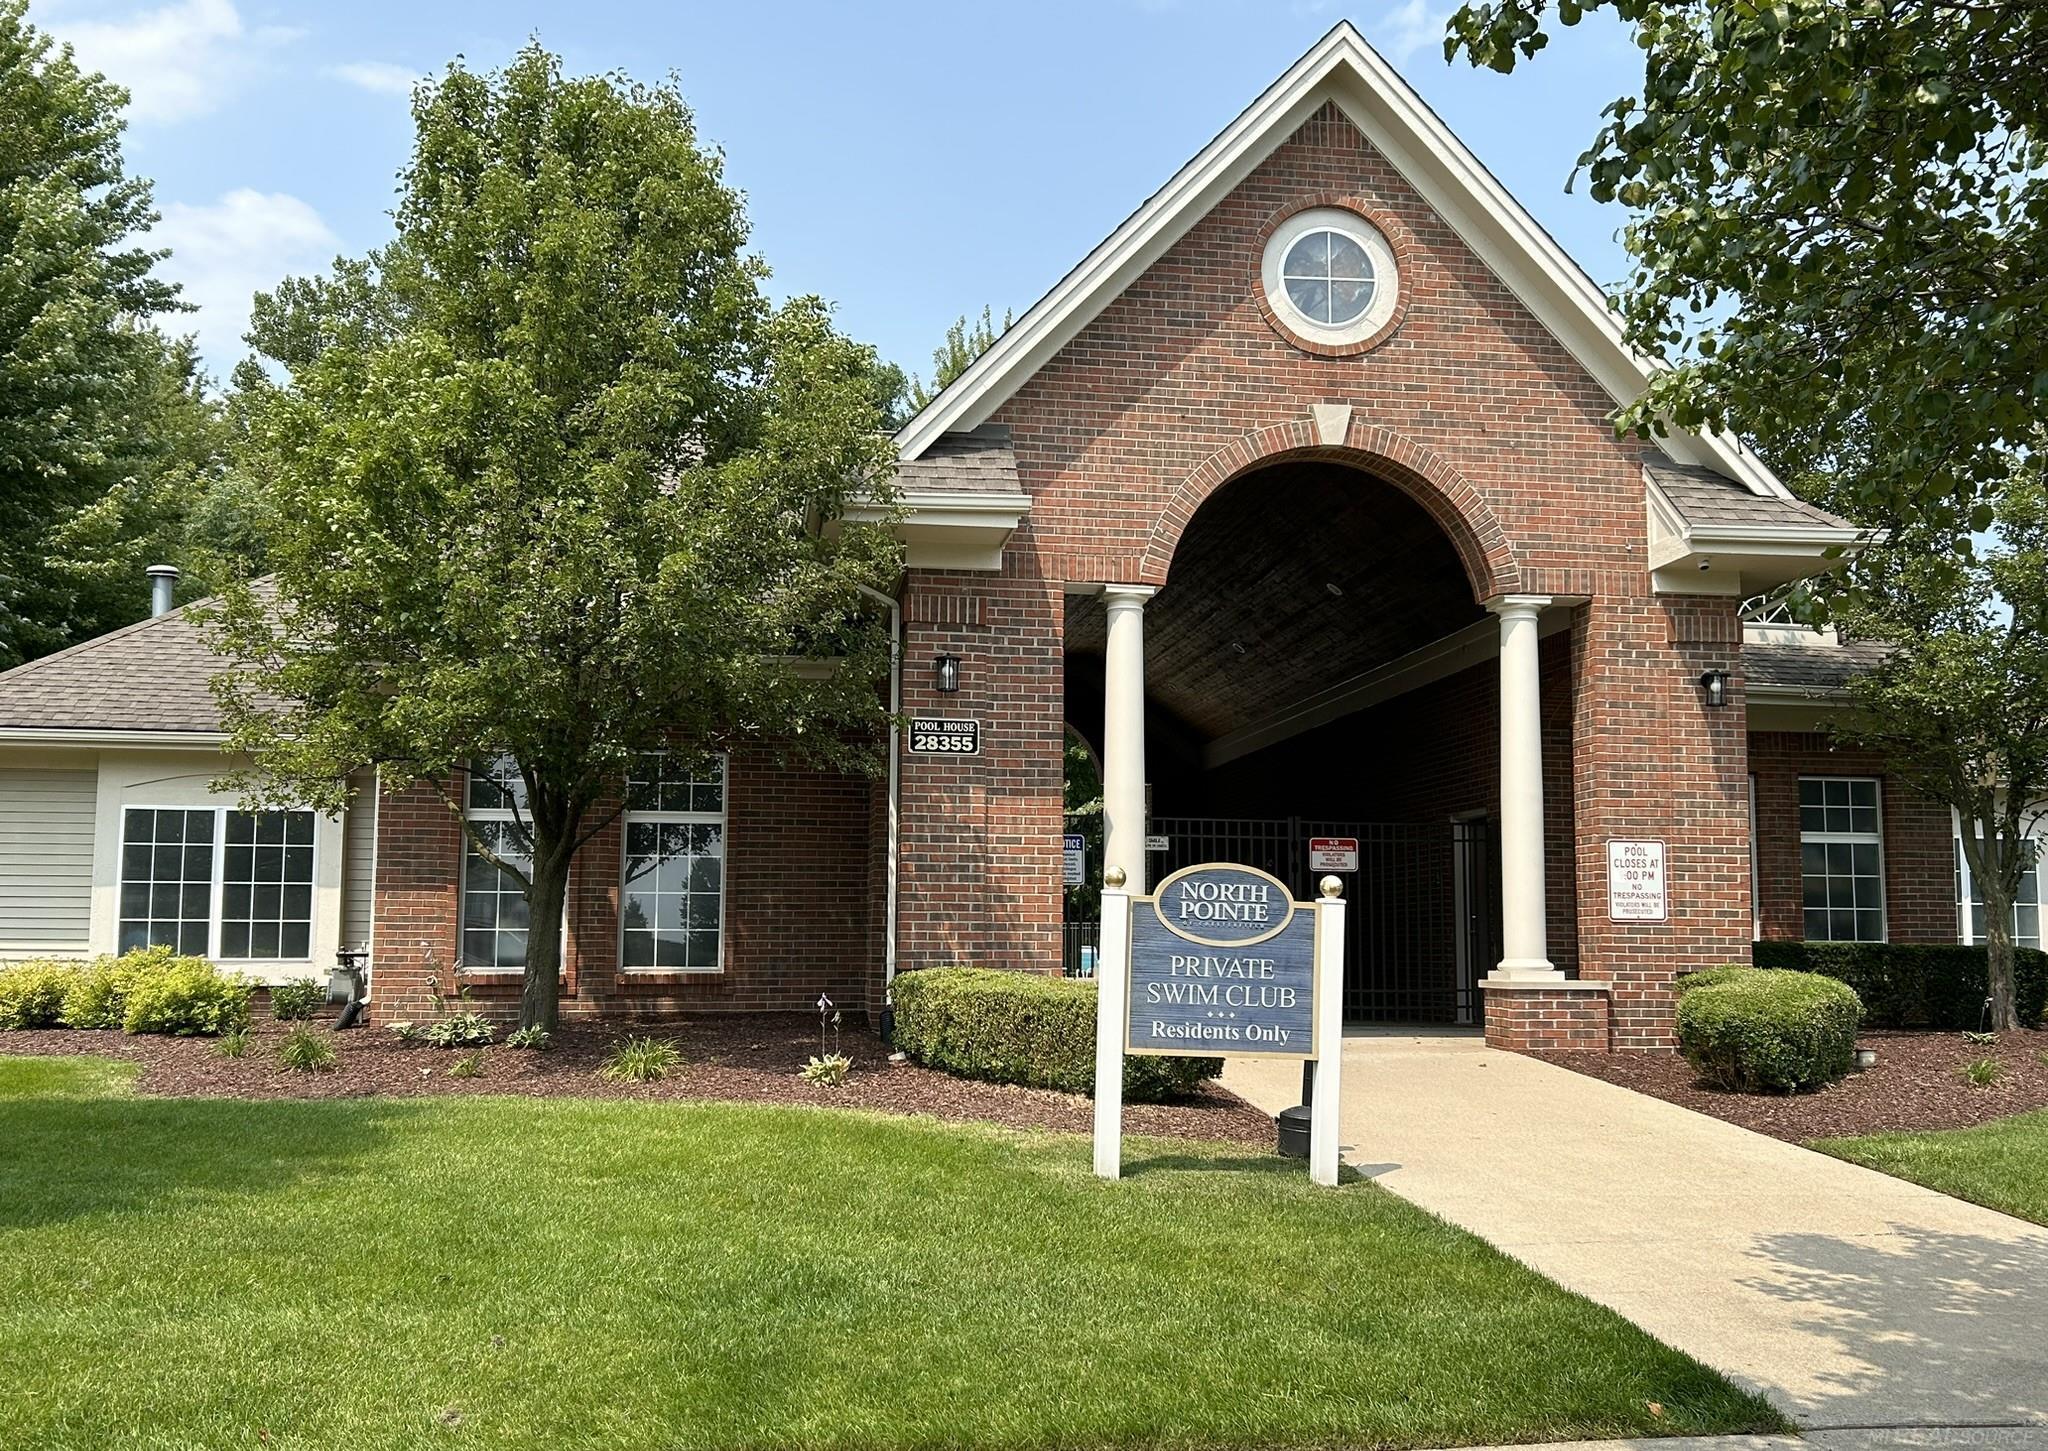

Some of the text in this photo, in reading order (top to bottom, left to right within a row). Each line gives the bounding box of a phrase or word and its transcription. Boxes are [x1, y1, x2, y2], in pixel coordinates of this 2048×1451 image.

[914, 721, 975, 732] POOL HOUSE
[914, 735, 974, 751] 28355
[1063, 839, 1081, 849] TICE
[1624, 847, 1648, 857] POOL
[1613, 858, 1659, 868] CLOSES AT
[1642, 871, 1655, 880] PM
[1181, 881, 1269, 903] NORTH
[1179, 902, 1269, 922] POINTE
[1170, 955, 1275, 980] PRIVATE
[1147, 982, 1296, 1008] SWIM CLUB
[1151, 1020, 1291, 1046] Residents Only
